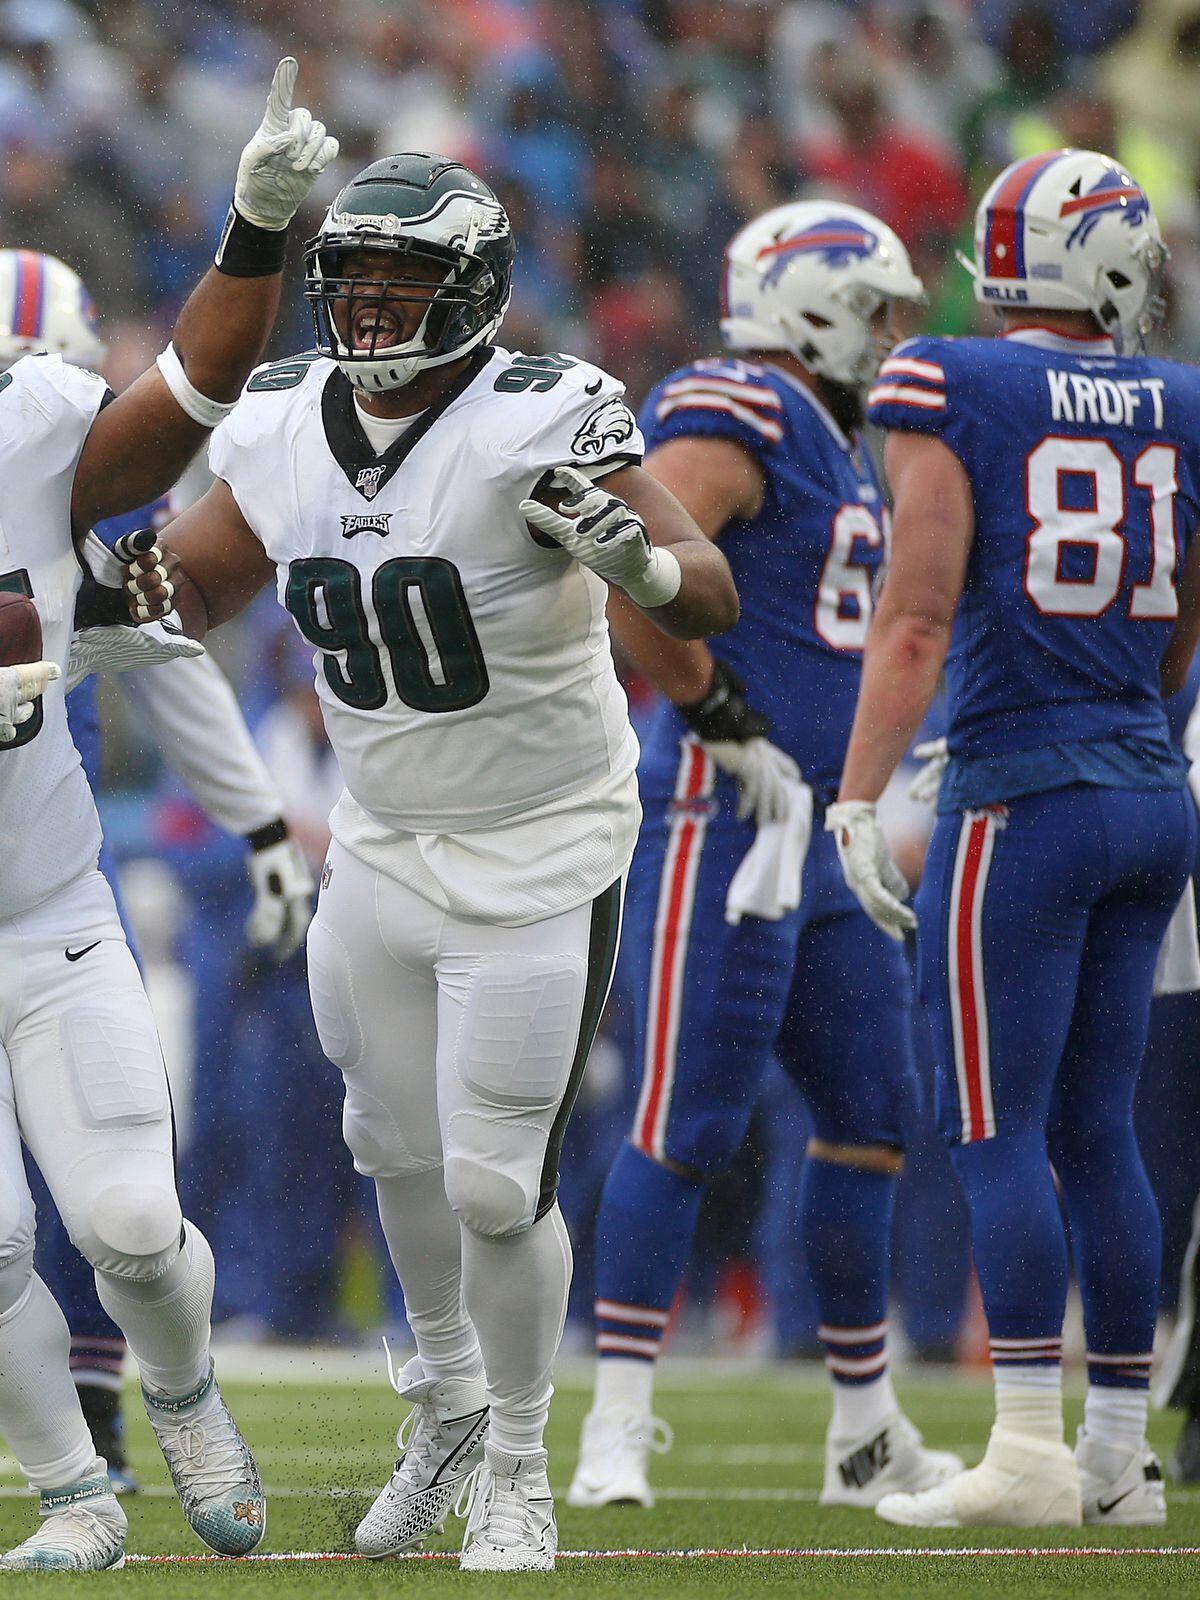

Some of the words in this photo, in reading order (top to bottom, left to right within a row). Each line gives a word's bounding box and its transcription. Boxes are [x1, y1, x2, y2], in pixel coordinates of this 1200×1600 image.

[983, 286, 1028, 301] BILLS
[1046, 368, 1165, 430] KROFT
[340, 513, 394, 540] EAGLES
[1023, 434, 1180, 622] 81
[813, 502, 893, 651] 6
[285, 556, 490, 713] 90
[450, 1440, 479, 1473] UNDER
[838, 1427, 892, 1491] NIKE
